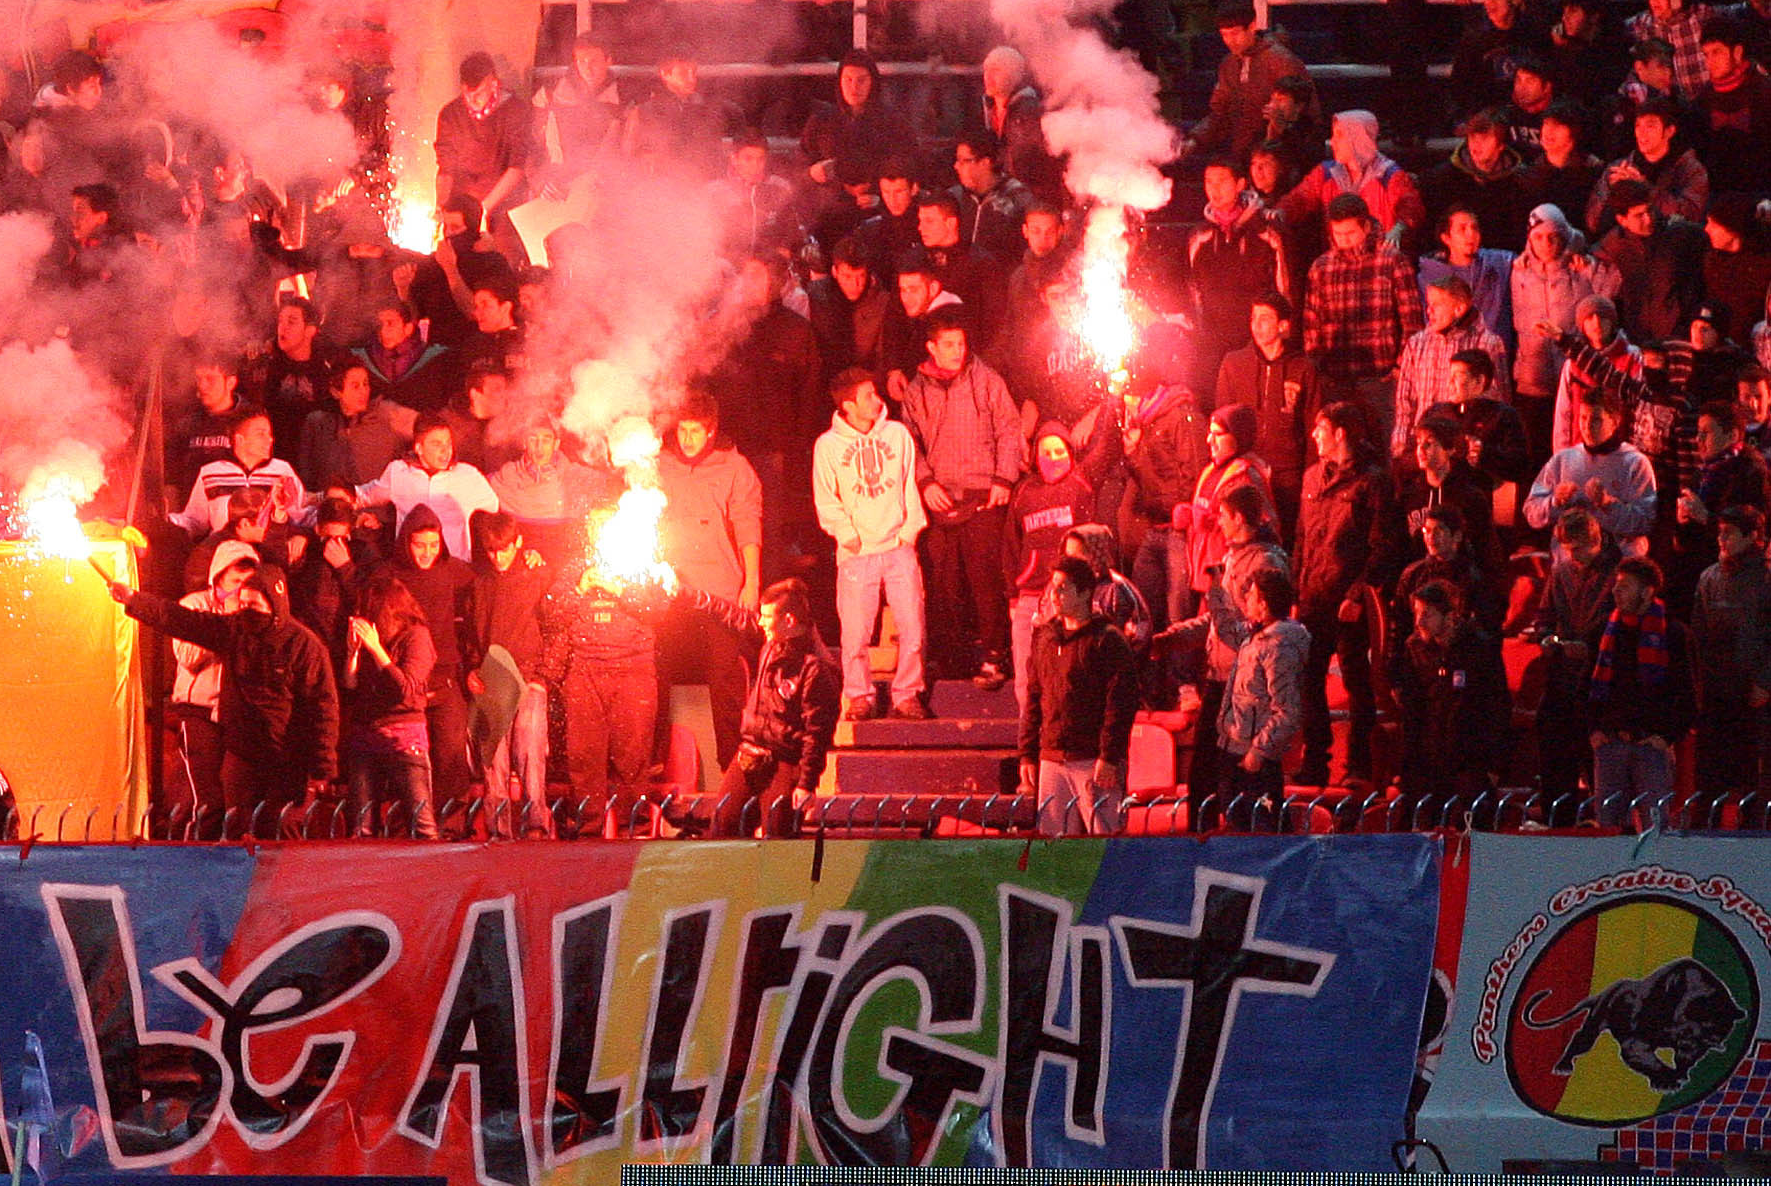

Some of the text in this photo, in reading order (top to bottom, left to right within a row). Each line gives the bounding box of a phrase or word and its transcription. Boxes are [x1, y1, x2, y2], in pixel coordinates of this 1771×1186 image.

[42, 883, 401, 1169] be
[1473, 914, 1547, 1063] Panthers
[1550, 865, 1695, 915] Creative
